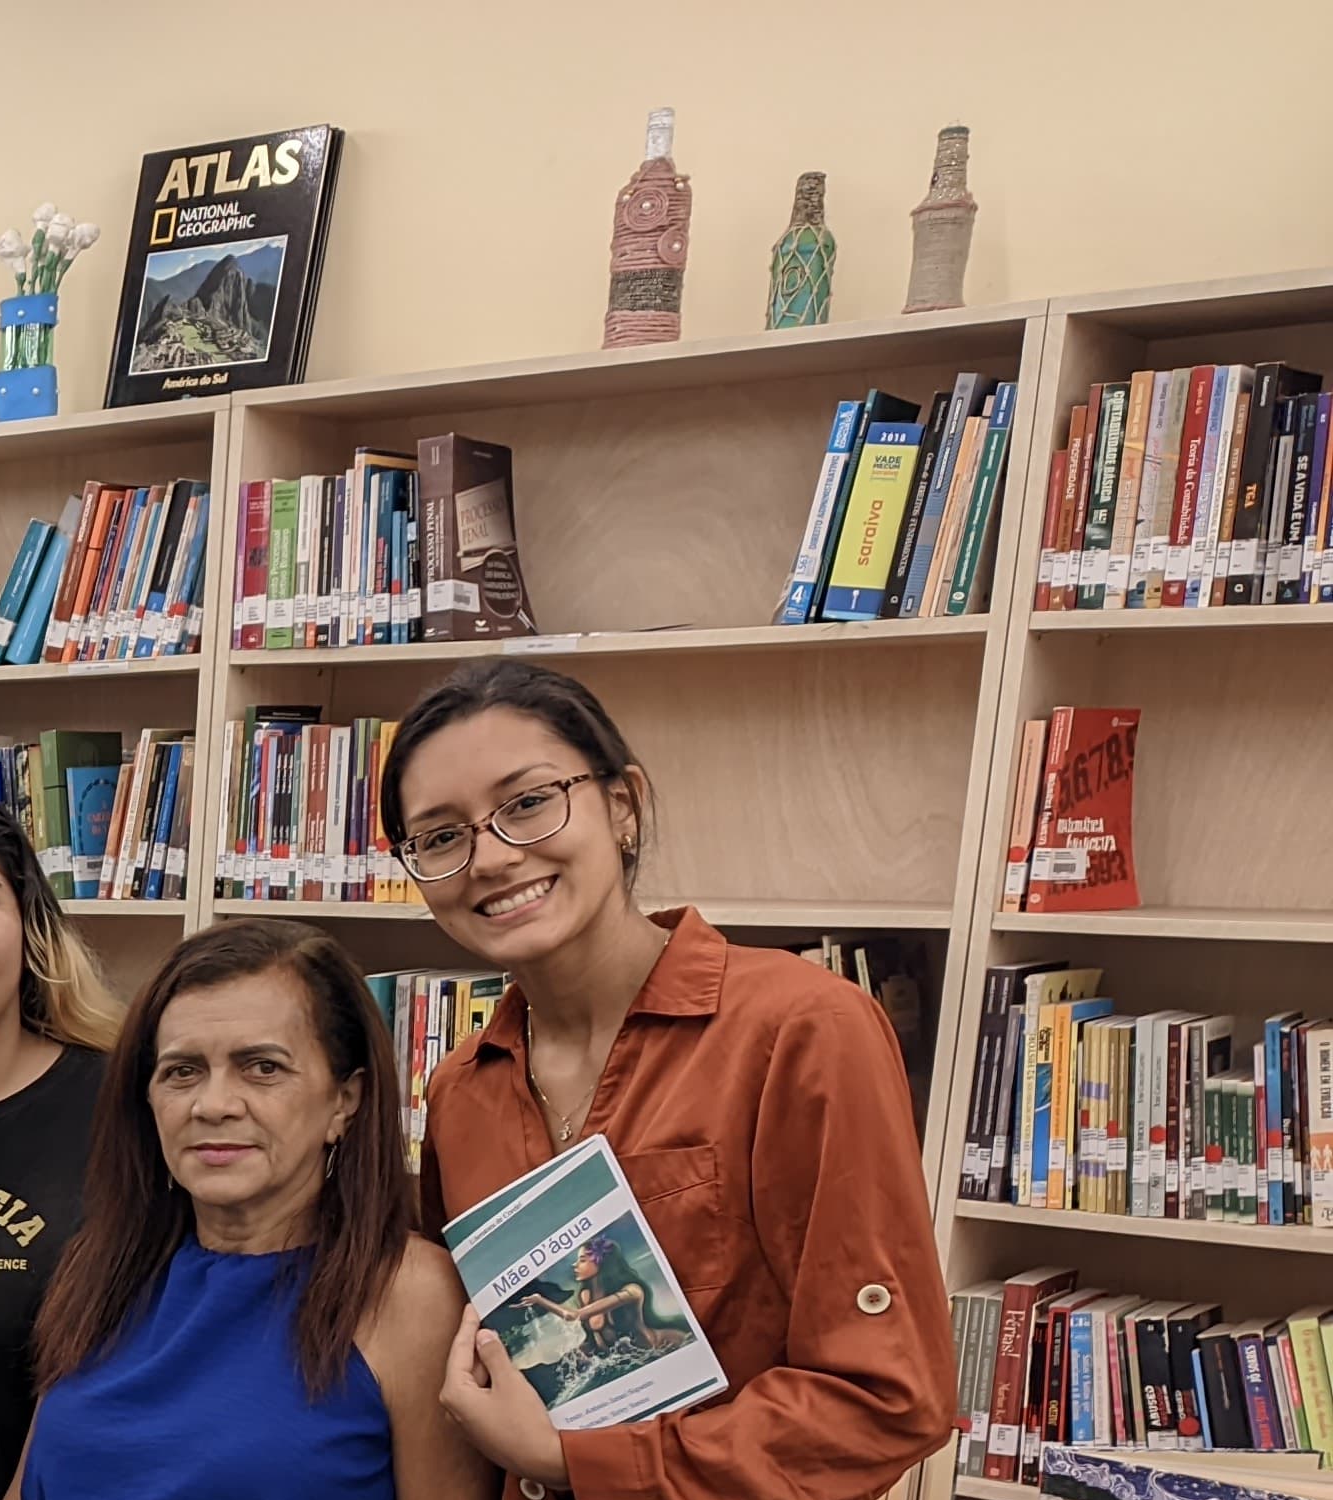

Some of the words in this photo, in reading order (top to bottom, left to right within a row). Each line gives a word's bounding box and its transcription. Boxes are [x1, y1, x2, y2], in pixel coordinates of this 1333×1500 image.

[155, 139, 303, 203] ATLAS
[176, 213, 257, 238] GEOGRAPHIC
[179, 201, 241, 223] NATIONAL
[162, 376, 199, 390] América
[200, 375, 212, 385] do
[212, 372, 229, 384] Sul
[1107, 390, 1126, 466] CONTABILIDADE
[874, 455, 902, 464] VADE
[1188, 437, 1201, 467] Teoria
[1066, 437, 1081, 501] PROSPERIDADE
[1099, 466, 1117, 503] BÁSICA
[1244, 483, 1258, 508] TGA
[1292, 481, 1307, 510] VIDA
[426, 501, 435, 531] PENAL
[1177, 481, 1195, 545] Contabilidade
[858, 499, 884, 566] saraiva
[1289, 522, 1302, 543] UM
[791, 585, 804, 603] 4
[1319, 1049, 1330, 1072] HOMEM
[1321, 1087, 1332, 1119] EVOLUÇÃO
[492, 1263, 530, 1297] Mãe
[1001, 1309, 1026, 1360] Férias!
